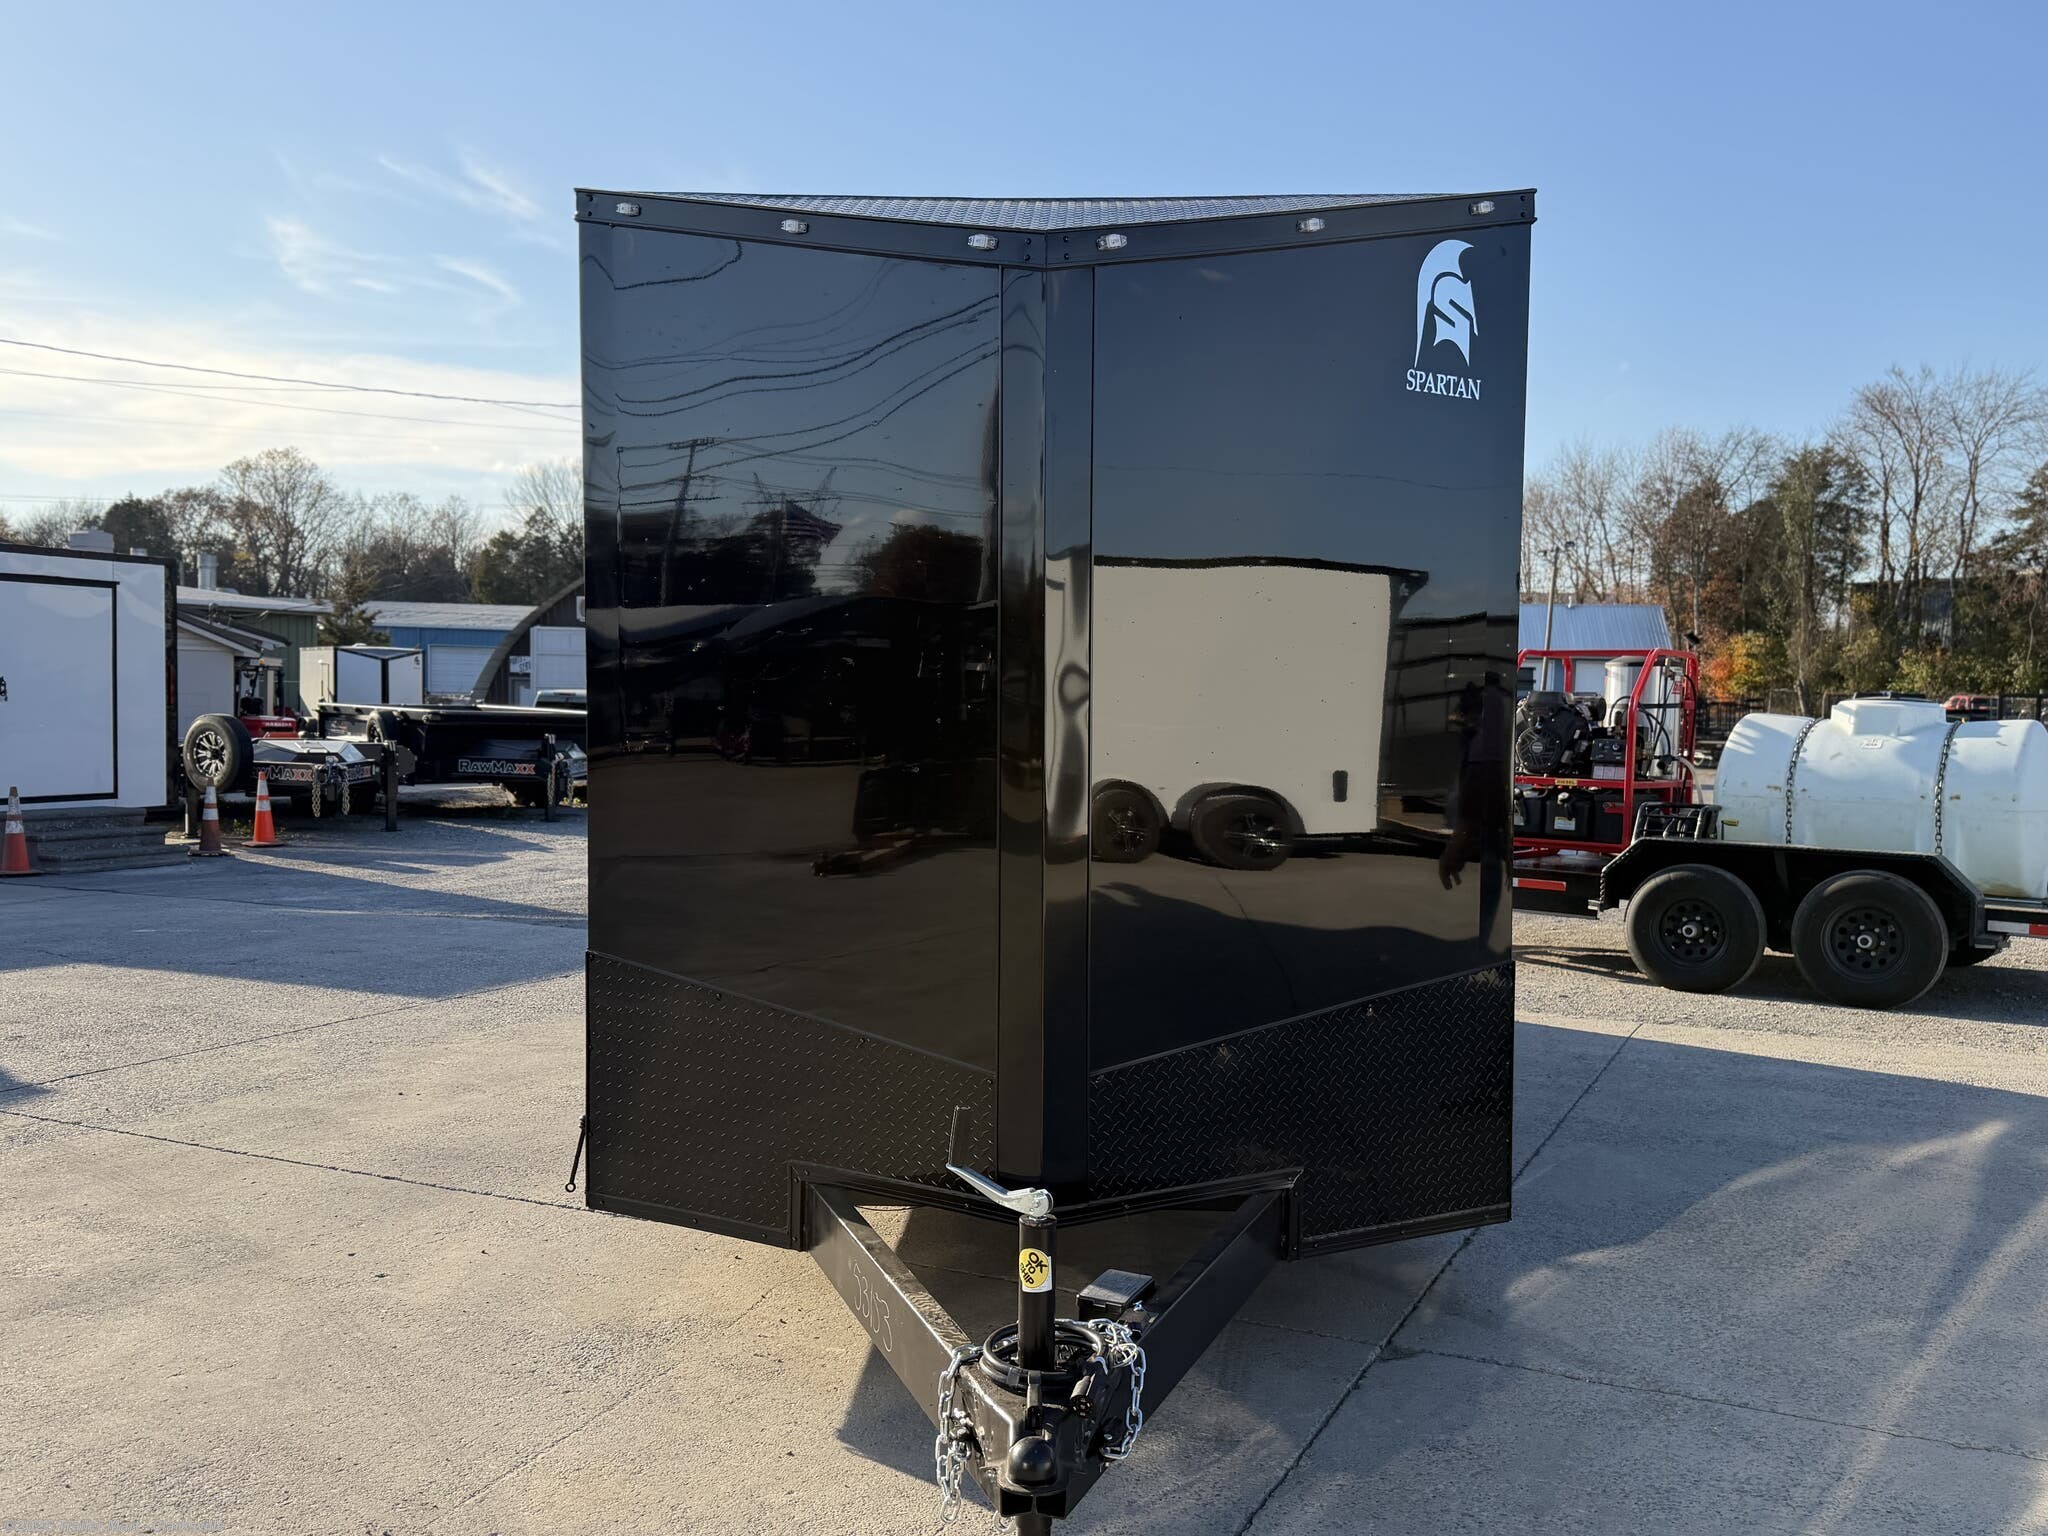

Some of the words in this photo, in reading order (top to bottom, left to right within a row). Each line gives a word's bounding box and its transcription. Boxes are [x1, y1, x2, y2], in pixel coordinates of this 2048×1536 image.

[1406, 368, 1481, 400] SPARTAN
[1025, 1261, 1036, 1274] TO
[1029, 1252, 1048, 1274] OK
